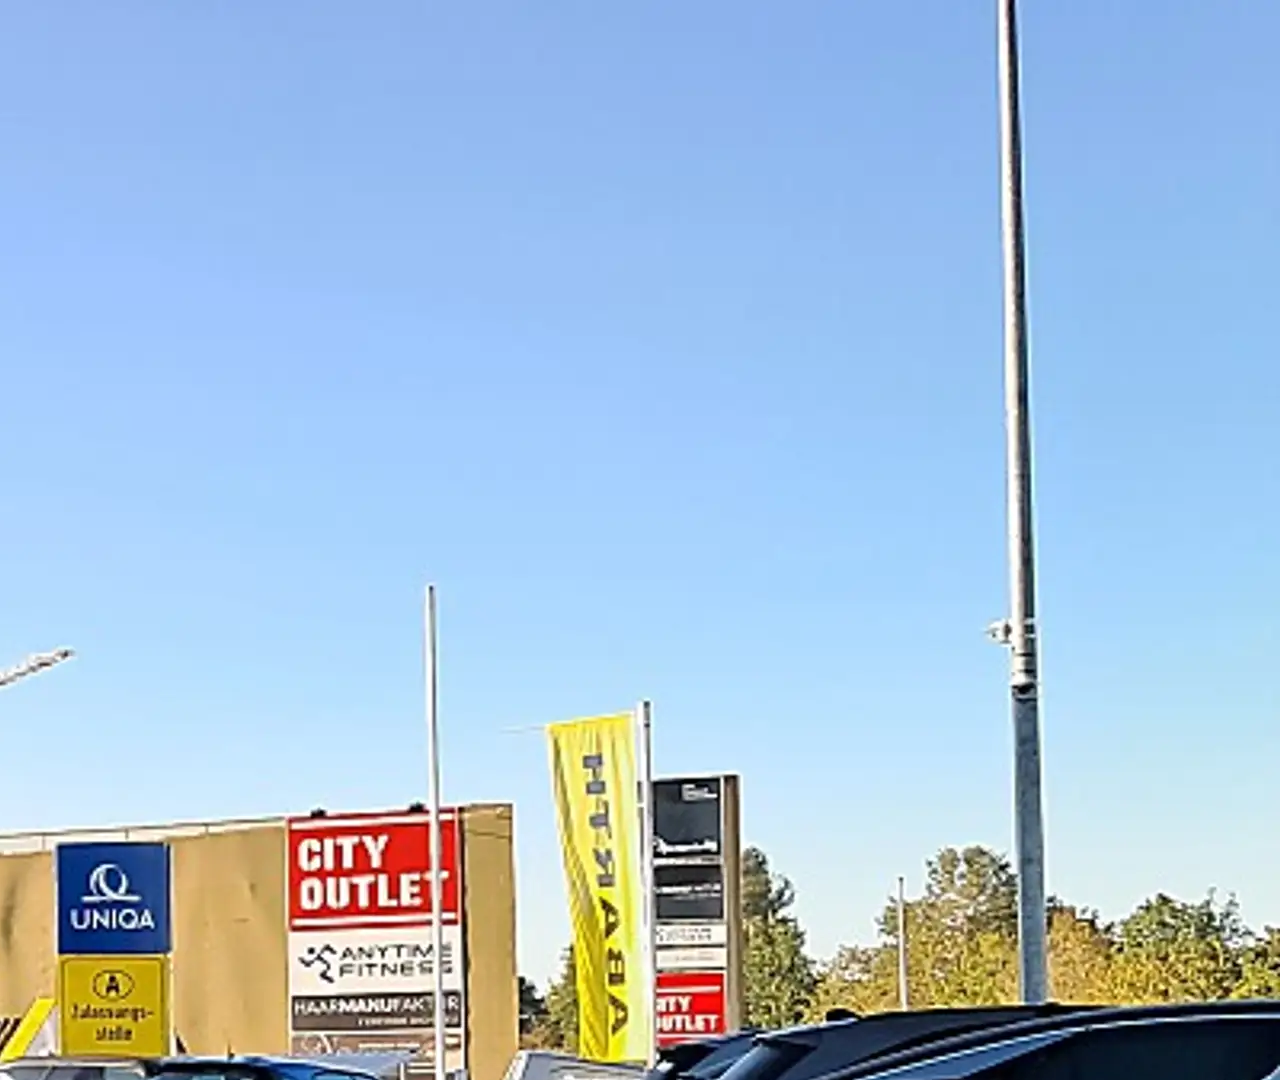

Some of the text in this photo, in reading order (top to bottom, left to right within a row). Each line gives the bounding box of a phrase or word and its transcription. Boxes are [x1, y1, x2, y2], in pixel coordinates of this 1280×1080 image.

[298, 834, 388, 871] CITY
[70, 907, 156, 931] UNIQA
[105, 974, 121, 994] A
[293, 995, 459, 1016] HAARMANUFAKTR
